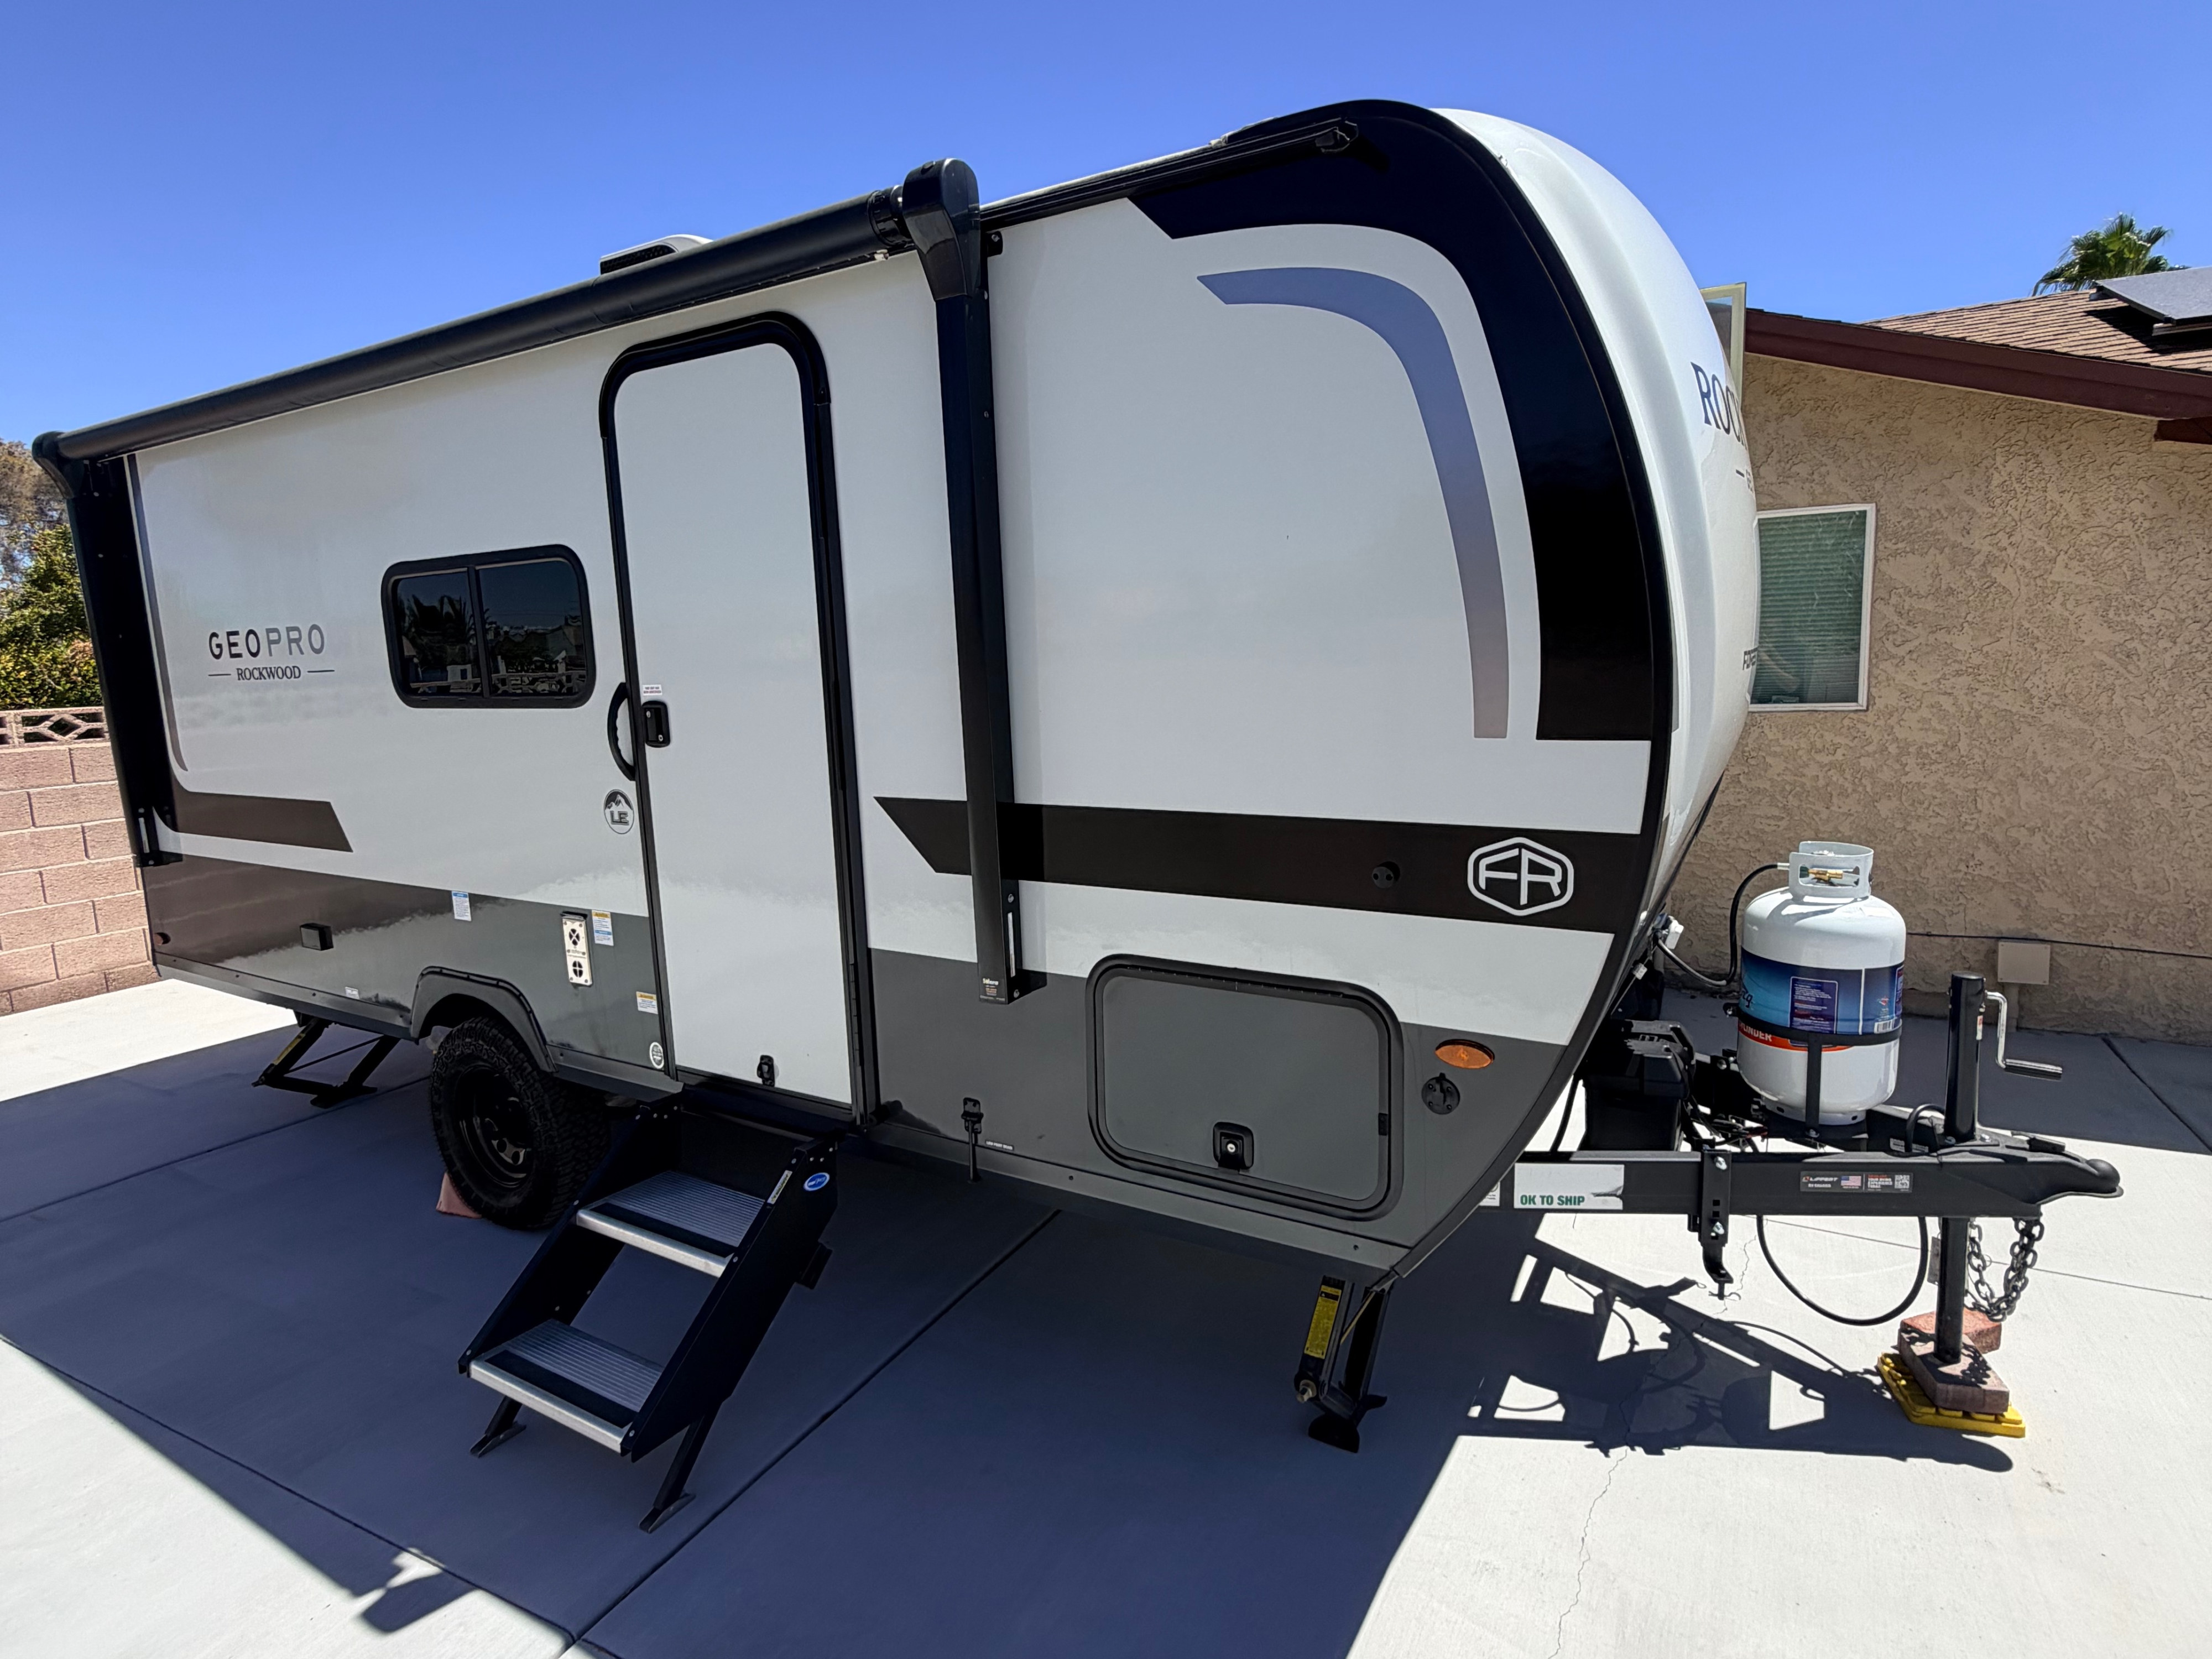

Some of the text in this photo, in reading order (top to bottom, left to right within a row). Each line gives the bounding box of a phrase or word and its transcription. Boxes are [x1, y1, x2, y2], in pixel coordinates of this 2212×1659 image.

[1691, 362, 1747, 451] ROC
[208, 624, 325, 660] GEOPRO
[236, 666, 301, 681] ROCKWOOD
[1739, 1021, 1772, 1042] LINDER
[1520, 1194, 1585, 1206] OK TO SHIP
